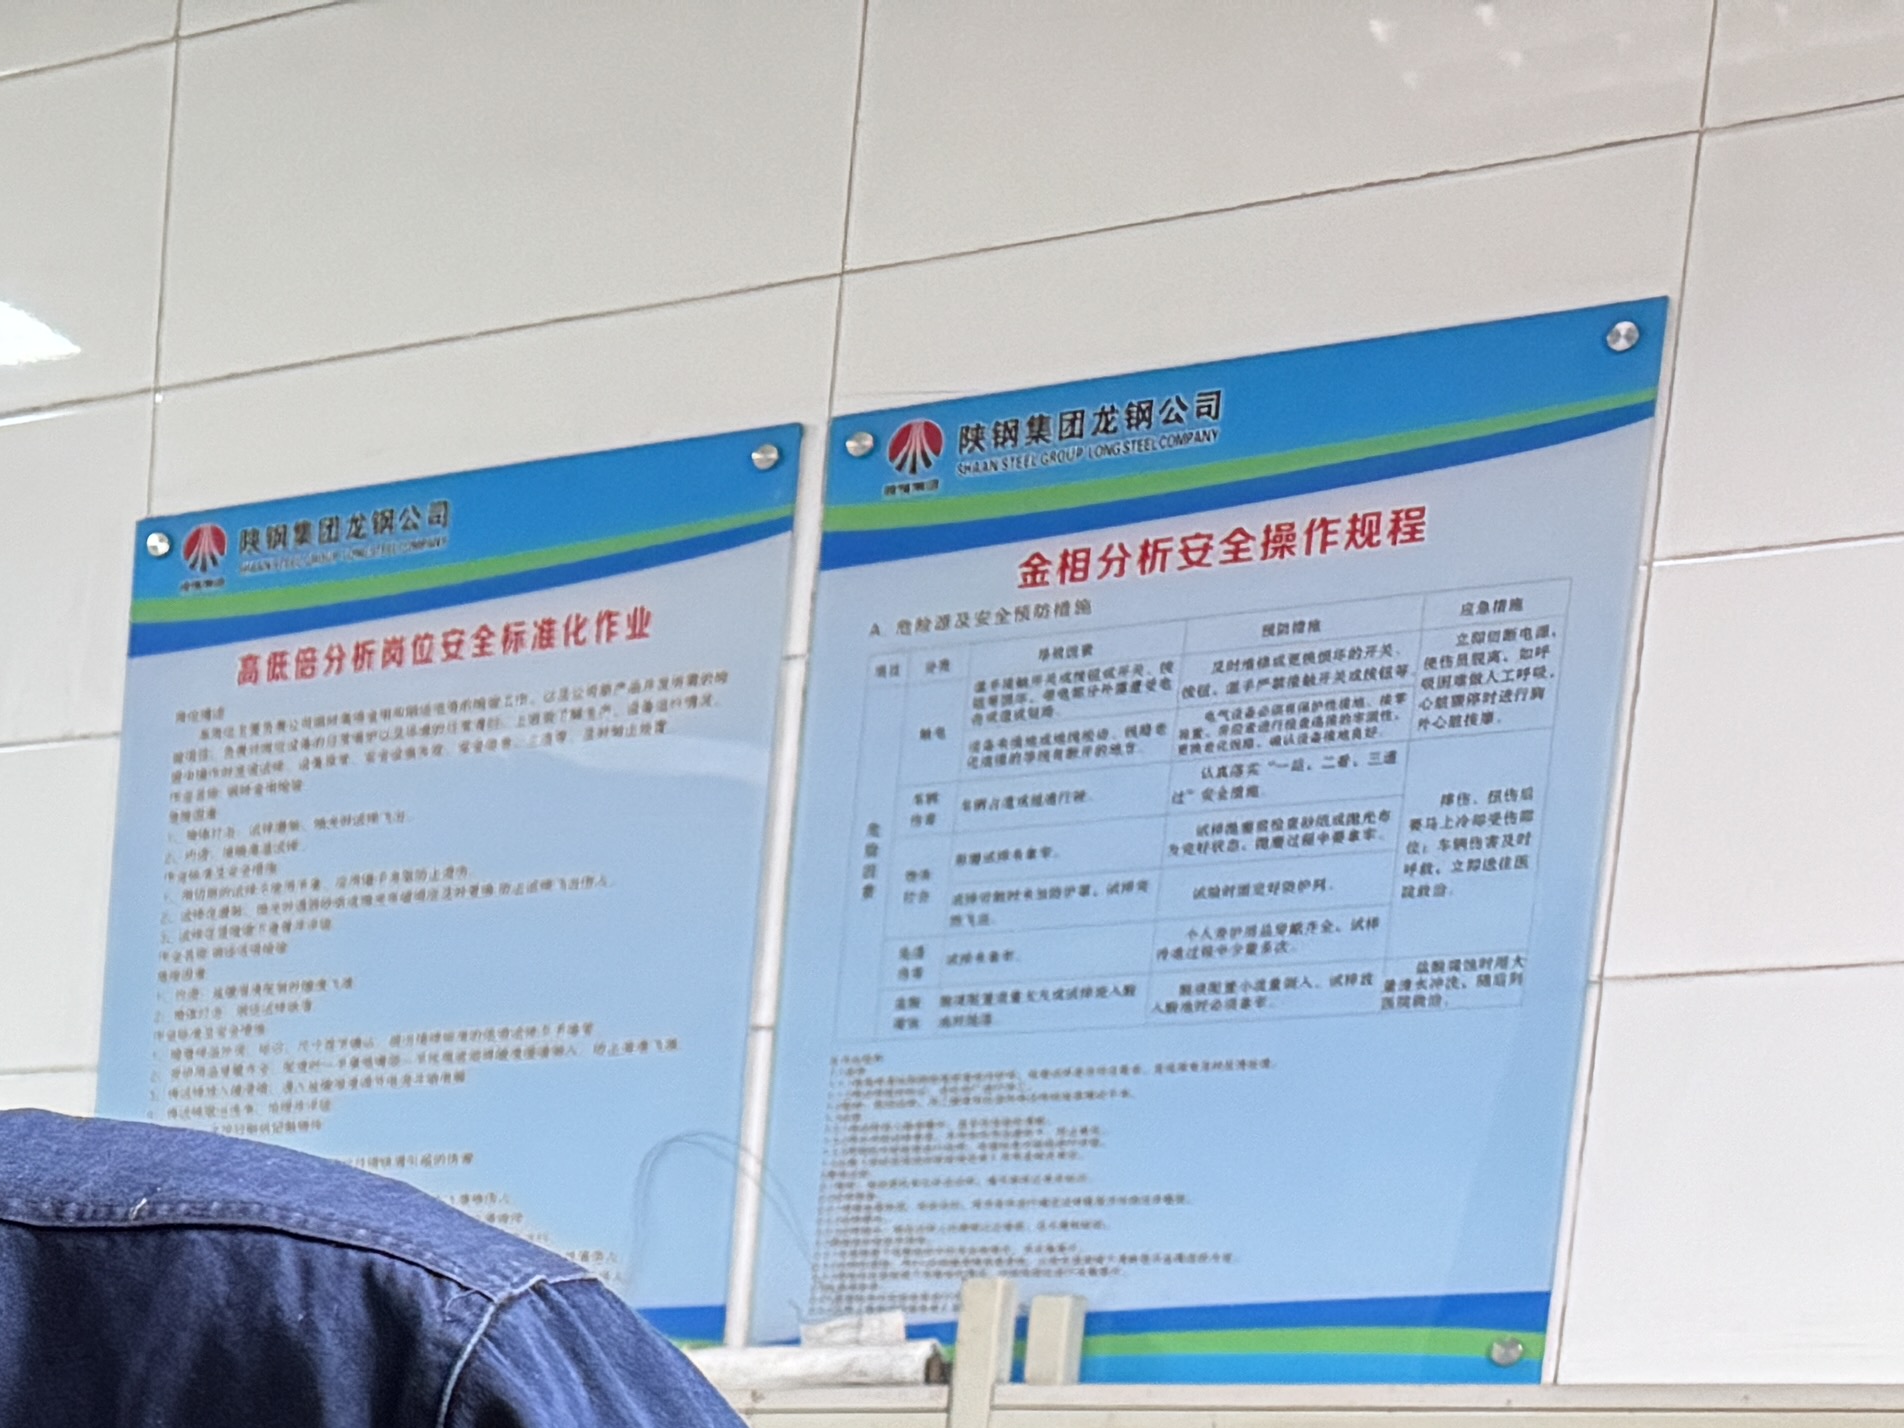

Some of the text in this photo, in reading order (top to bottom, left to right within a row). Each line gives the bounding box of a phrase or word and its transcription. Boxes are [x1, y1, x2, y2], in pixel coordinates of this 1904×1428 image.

[959, 390, 1222, 455] 陕钢集团龙钢公司
[1001, 454, 1038, 471] STEEL
[1040, 448, 1084, 465] GROUP
[1159, 429, 1220, 450] COMPANY
[240, 500, 449, 553] 陕钢集团龙钢公司
[1016, 505, 1429, 592] 金相分析安全操作规程
[237, 605, 653, 686] 高低倍分析岗位安全标准化作业
